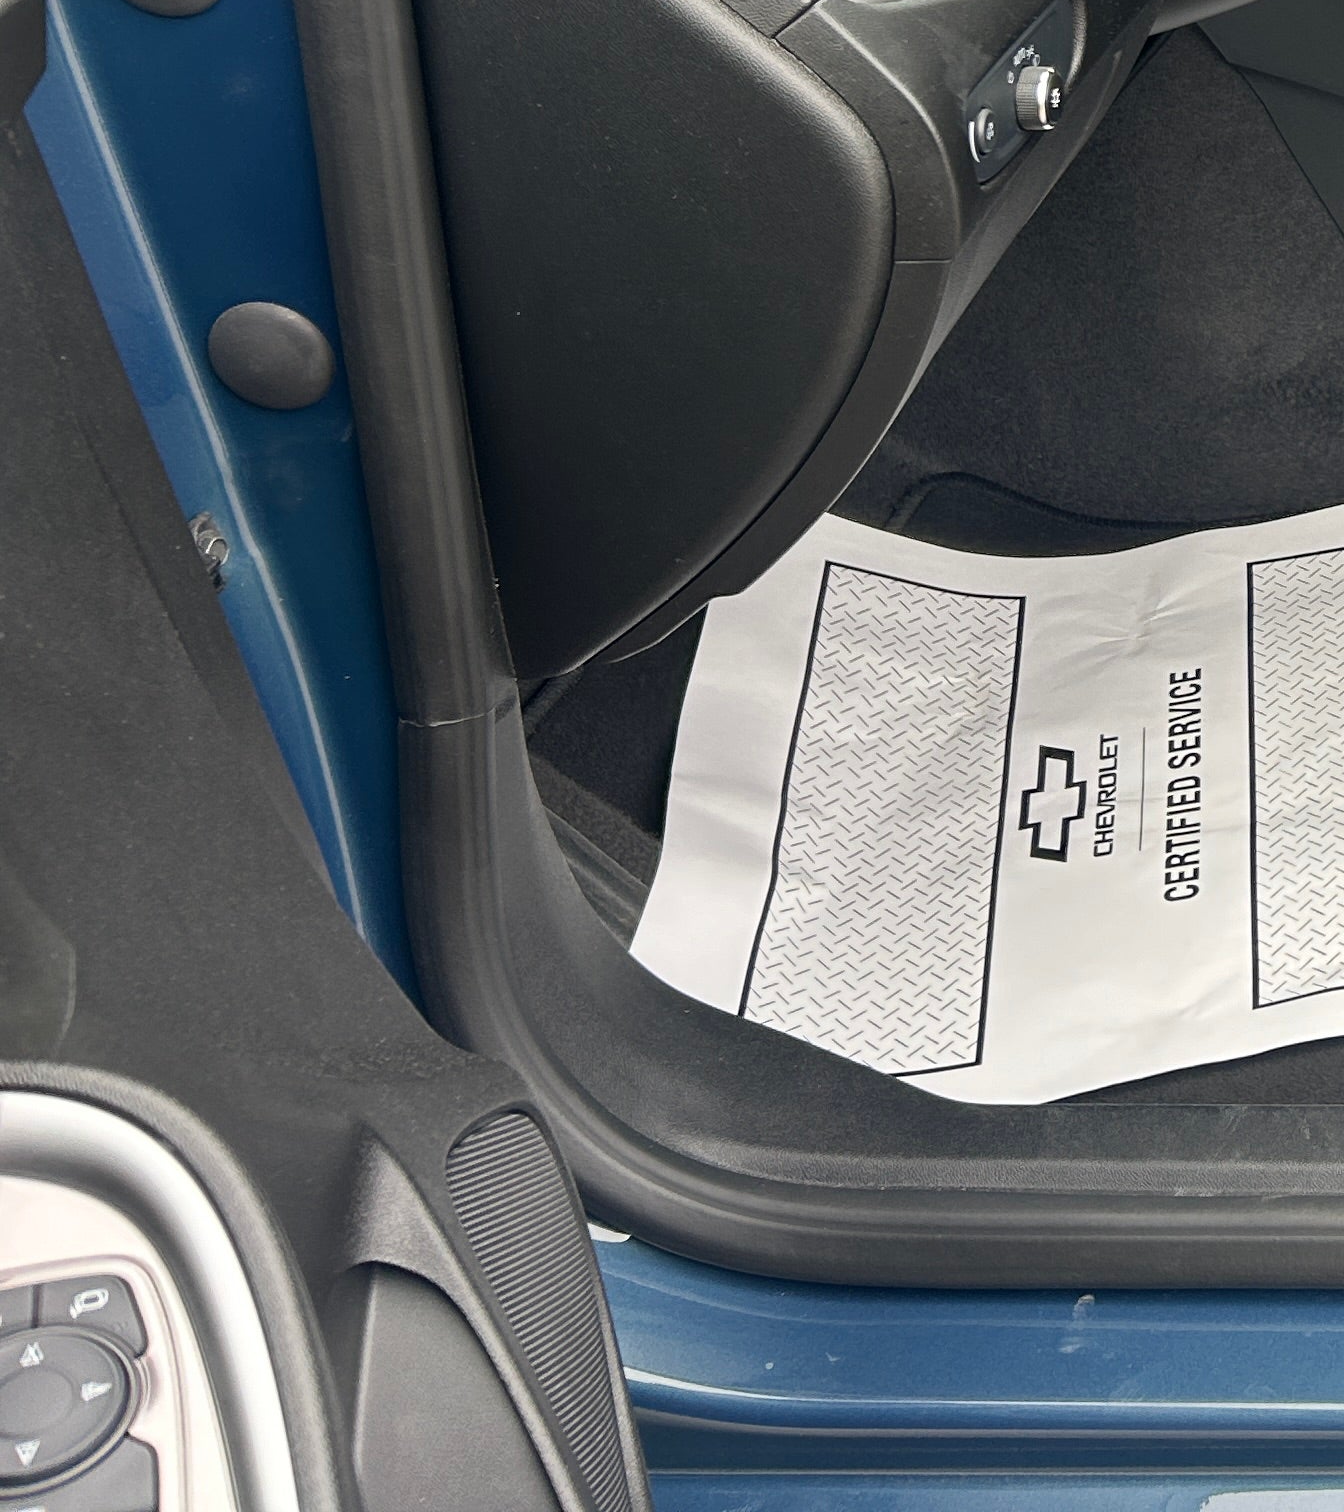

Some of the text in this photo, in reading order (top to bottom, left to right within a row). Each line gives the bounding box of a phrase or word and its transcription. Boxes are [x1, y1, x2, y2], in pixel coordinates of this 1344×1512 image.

[1093, 734, 1119, 857] CHEVROLET
[1164, 668, 1202, 902] CERTIFIED SERVICE
